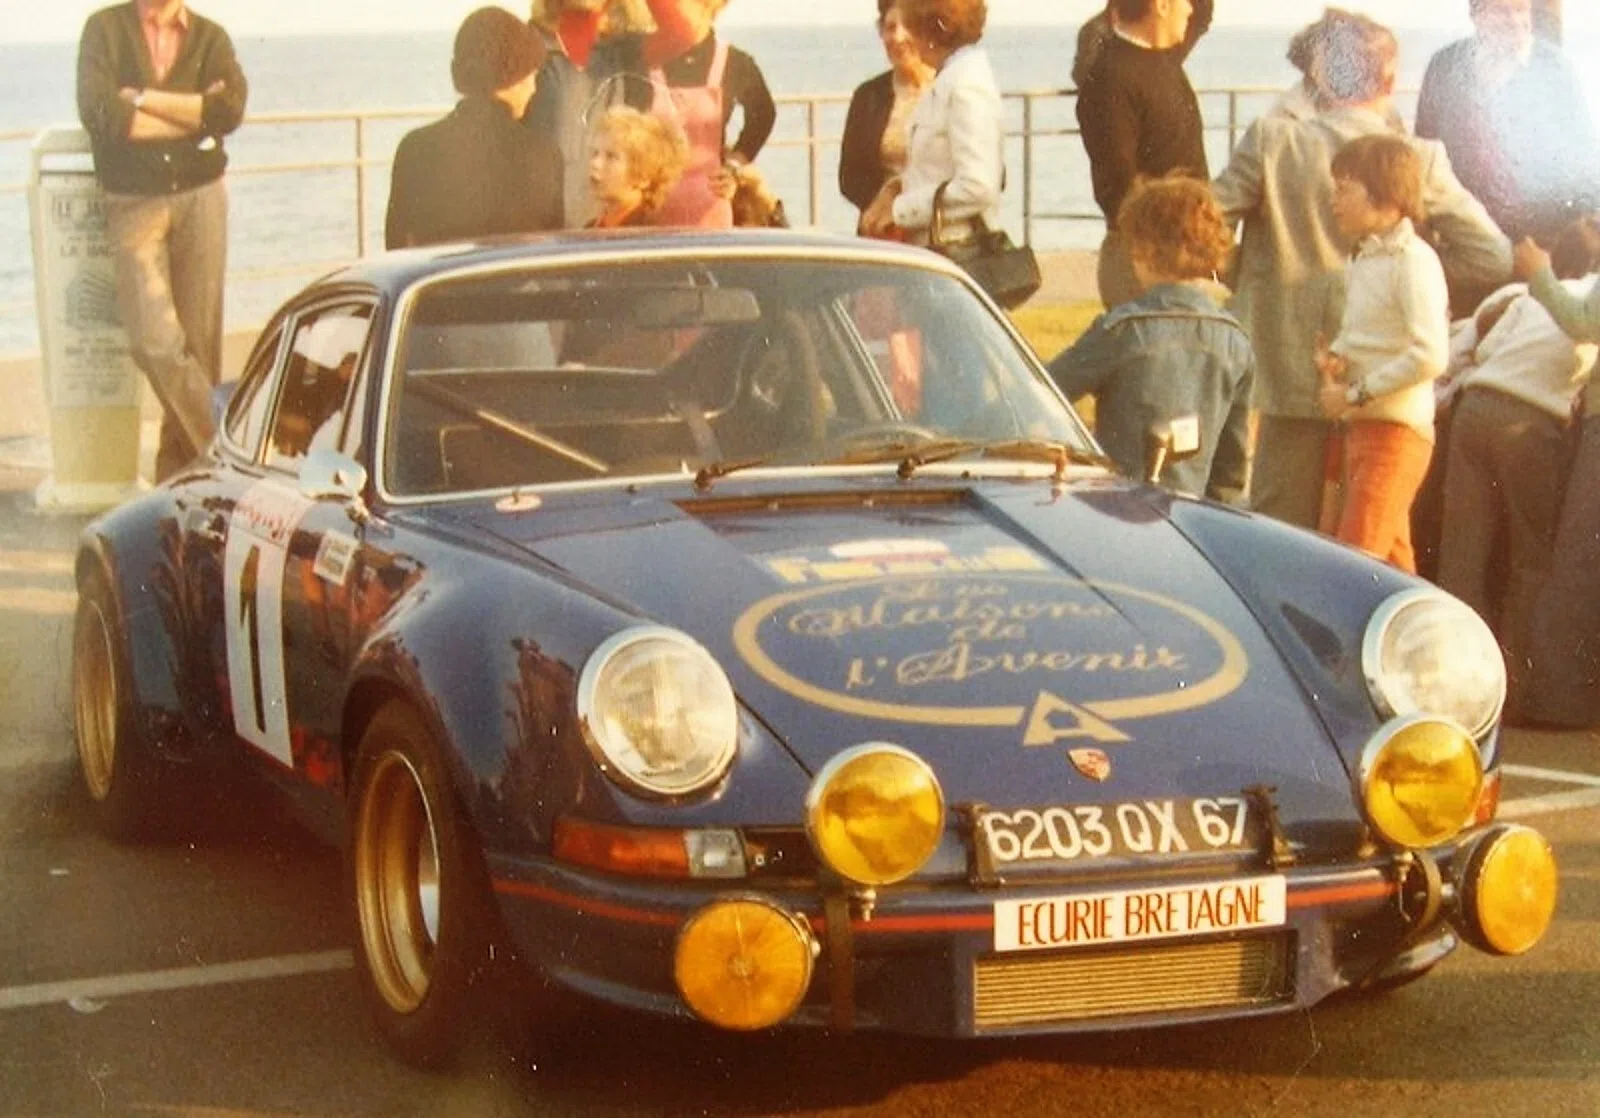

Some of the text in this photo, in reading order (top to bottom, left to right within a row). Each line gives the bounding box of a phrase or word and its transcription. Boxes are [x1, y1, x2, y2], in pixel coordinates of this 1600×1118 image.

[239, 545, 267, 735] 1
[948, 618, 1027, 647] de
[982, 796, 1248, 862] 6203 QX 67
[1017, 881, 1266, 947] ECURIE BRETAGNE
